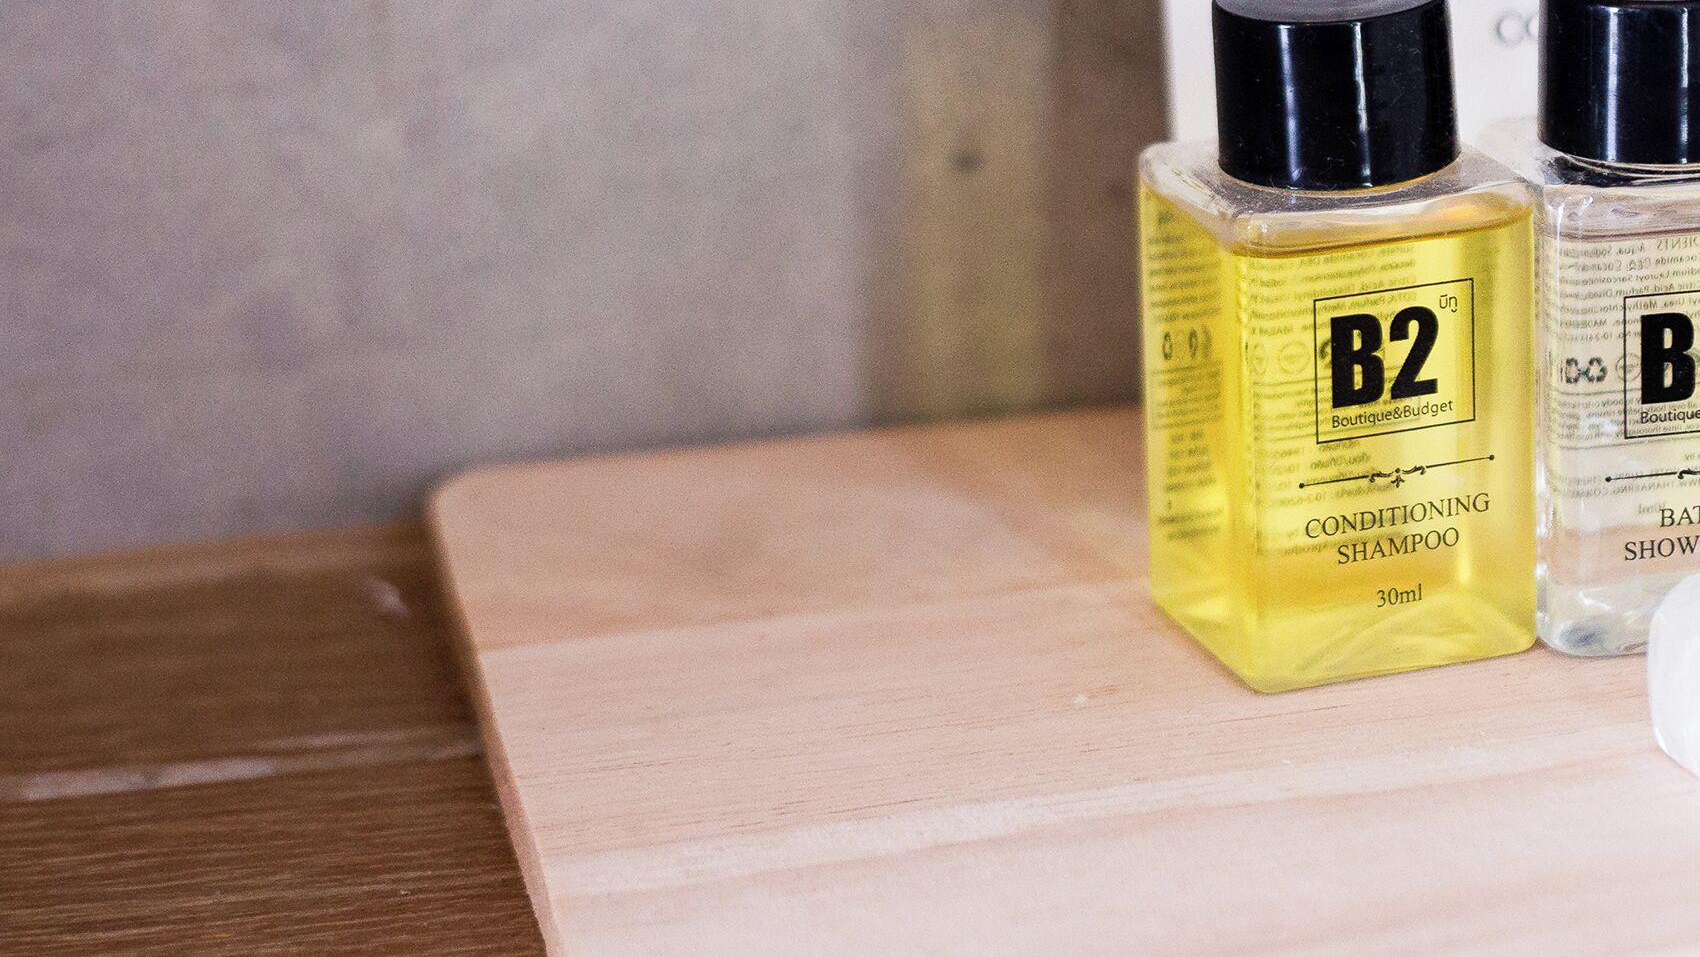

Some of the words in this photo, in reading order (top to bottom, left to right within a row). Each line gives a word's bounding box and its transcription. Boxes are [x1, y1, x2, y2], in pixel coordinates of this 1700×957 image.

[1331, 306, 1439, 409] B2
[1332, 400, 1453, 429] Boutique&Budget
[1305, 492, 1490, 539] CONDITIONING
[1337, 527, 1460, 564] SHAMPOO
[1377, 583, 1422, 608] 30ml
